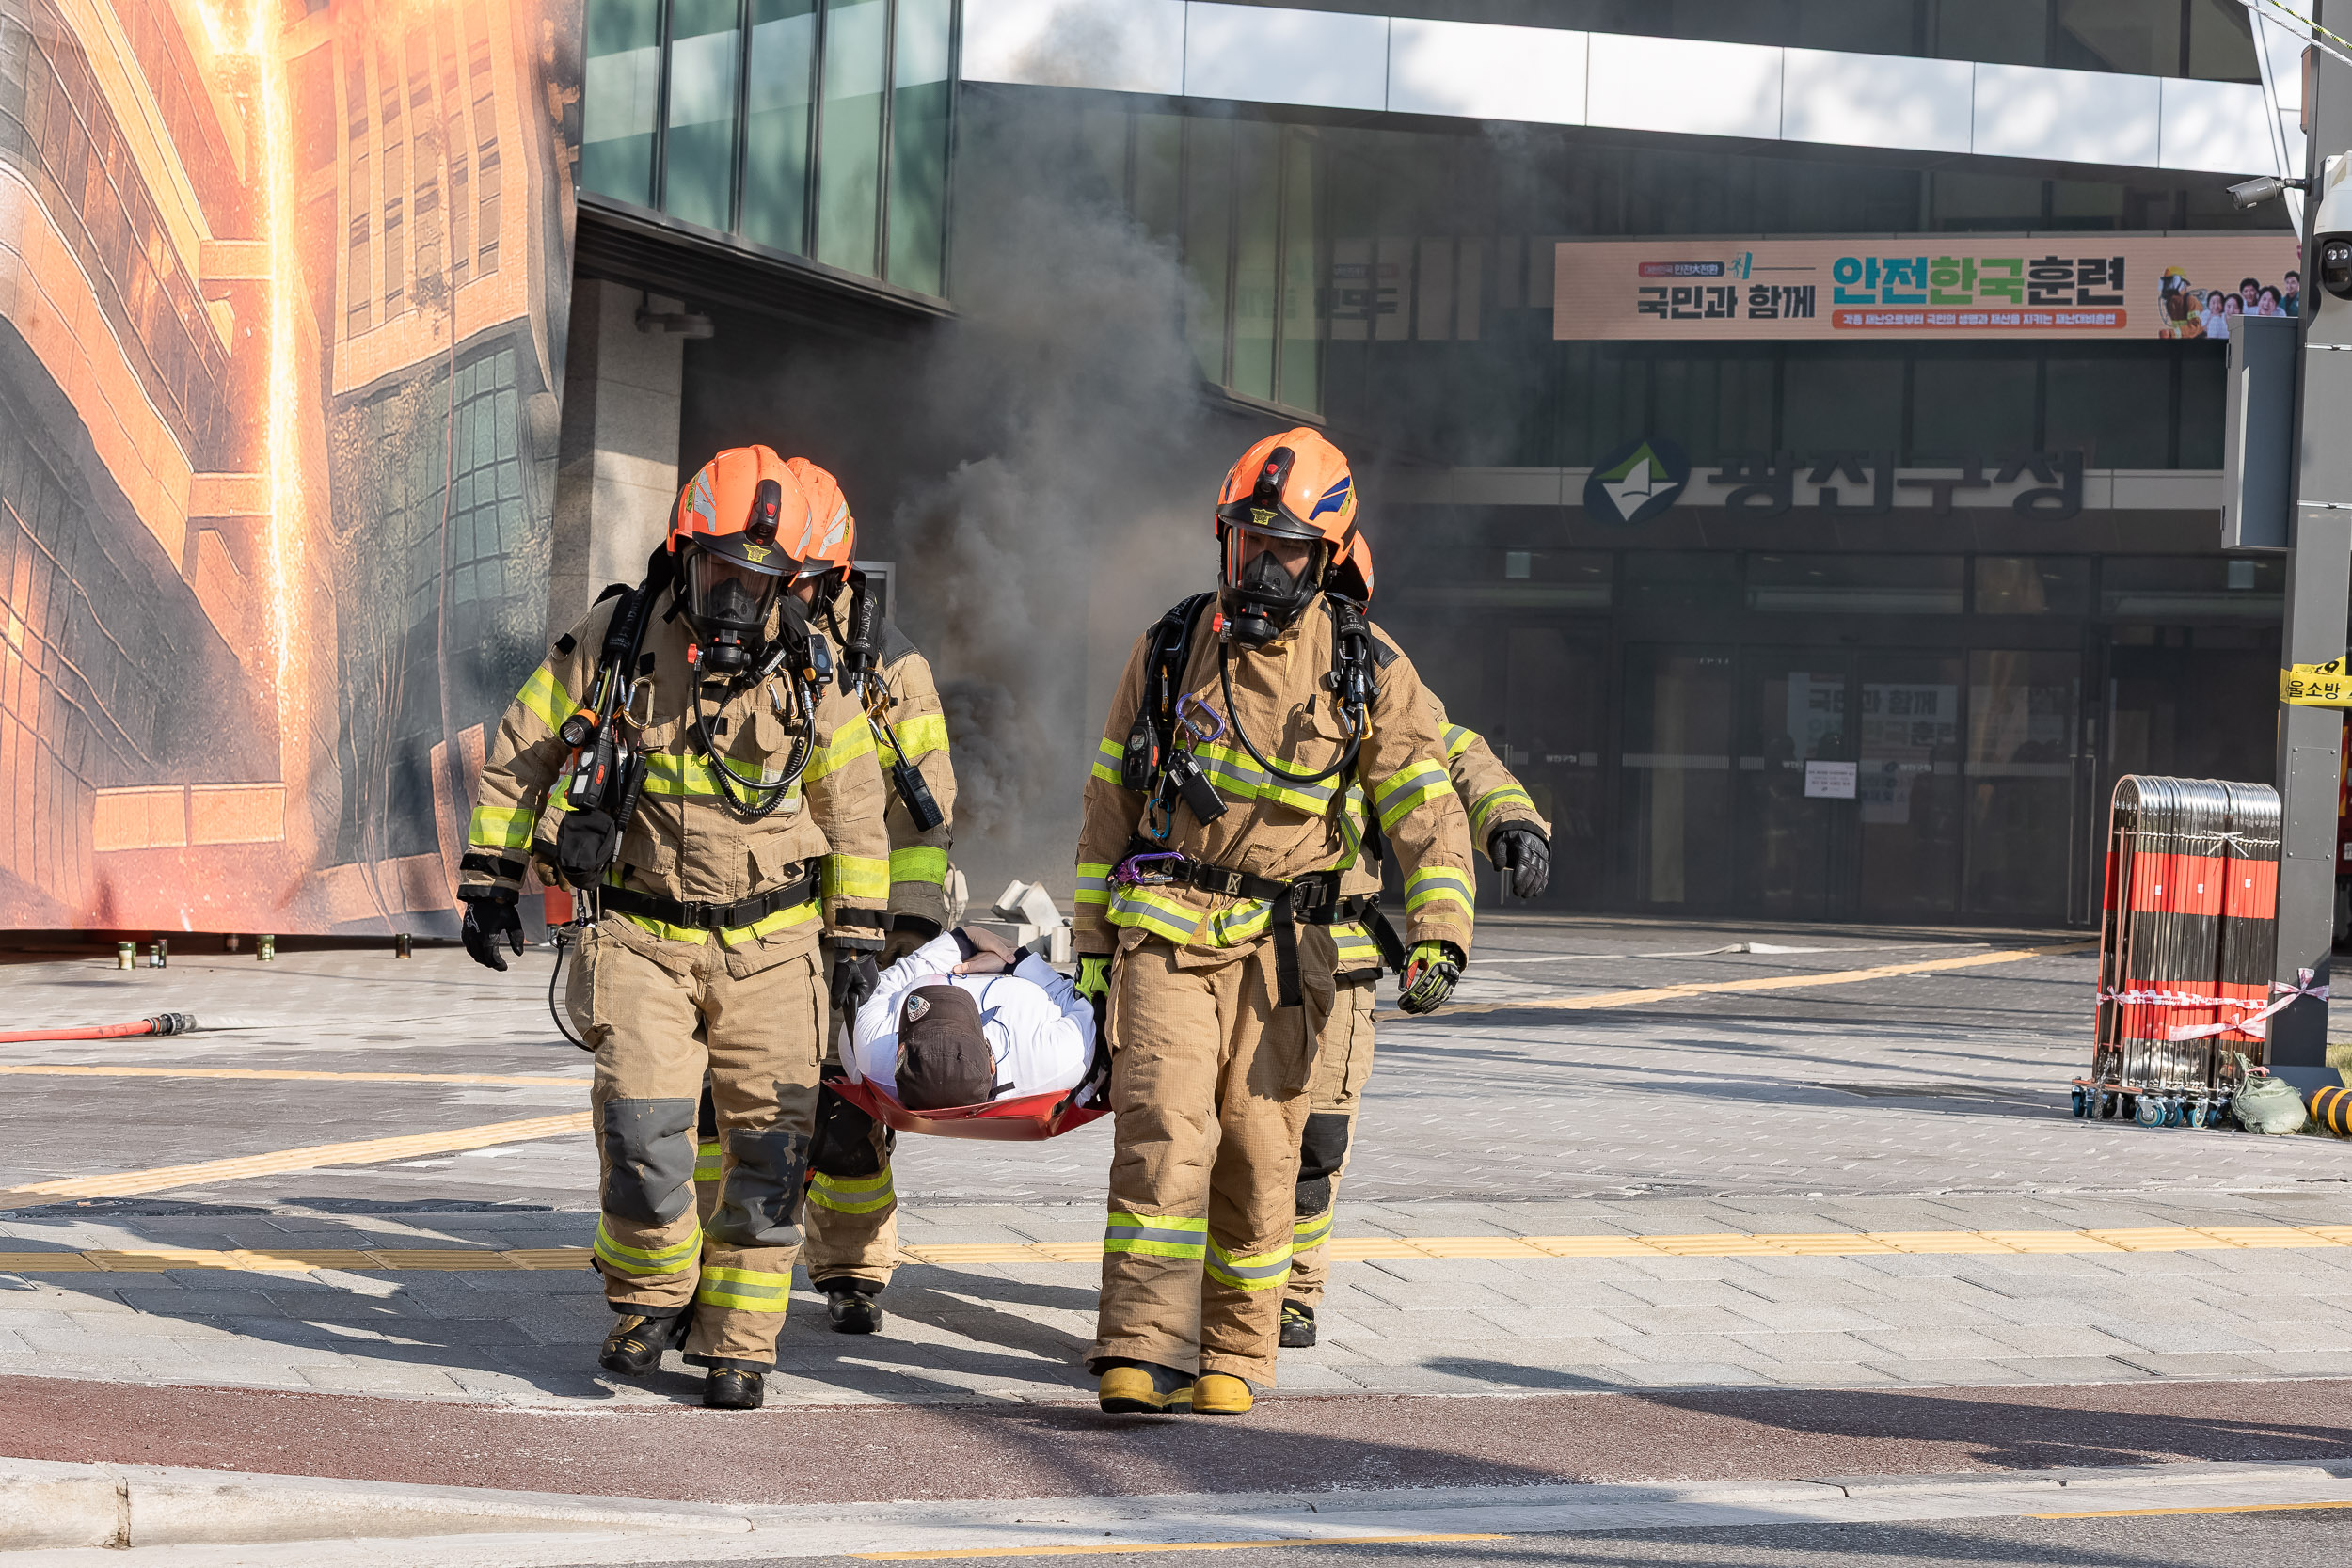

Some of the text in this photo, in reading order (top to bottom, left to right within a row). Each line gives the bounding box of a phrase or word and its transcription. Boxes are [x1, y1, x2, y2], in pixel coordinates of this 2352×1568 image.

[1833, 256, 2124, 305] 안전한국훈련
[1638, 284, 1816, 319] 국민과 함께
[1927, 313, 1956, 325] 국민의
[1958, 313, 1988, 325] 생명과
[1990, 313, 2020, 325] 재산을
[2023, 313, 2053, 325] 지키는
[2055, 313, 2116, 325] 재난대비훈련
[1707, 449, 2084, 521] 광진구청
[2285, 679, 2341, 700] 울소방
